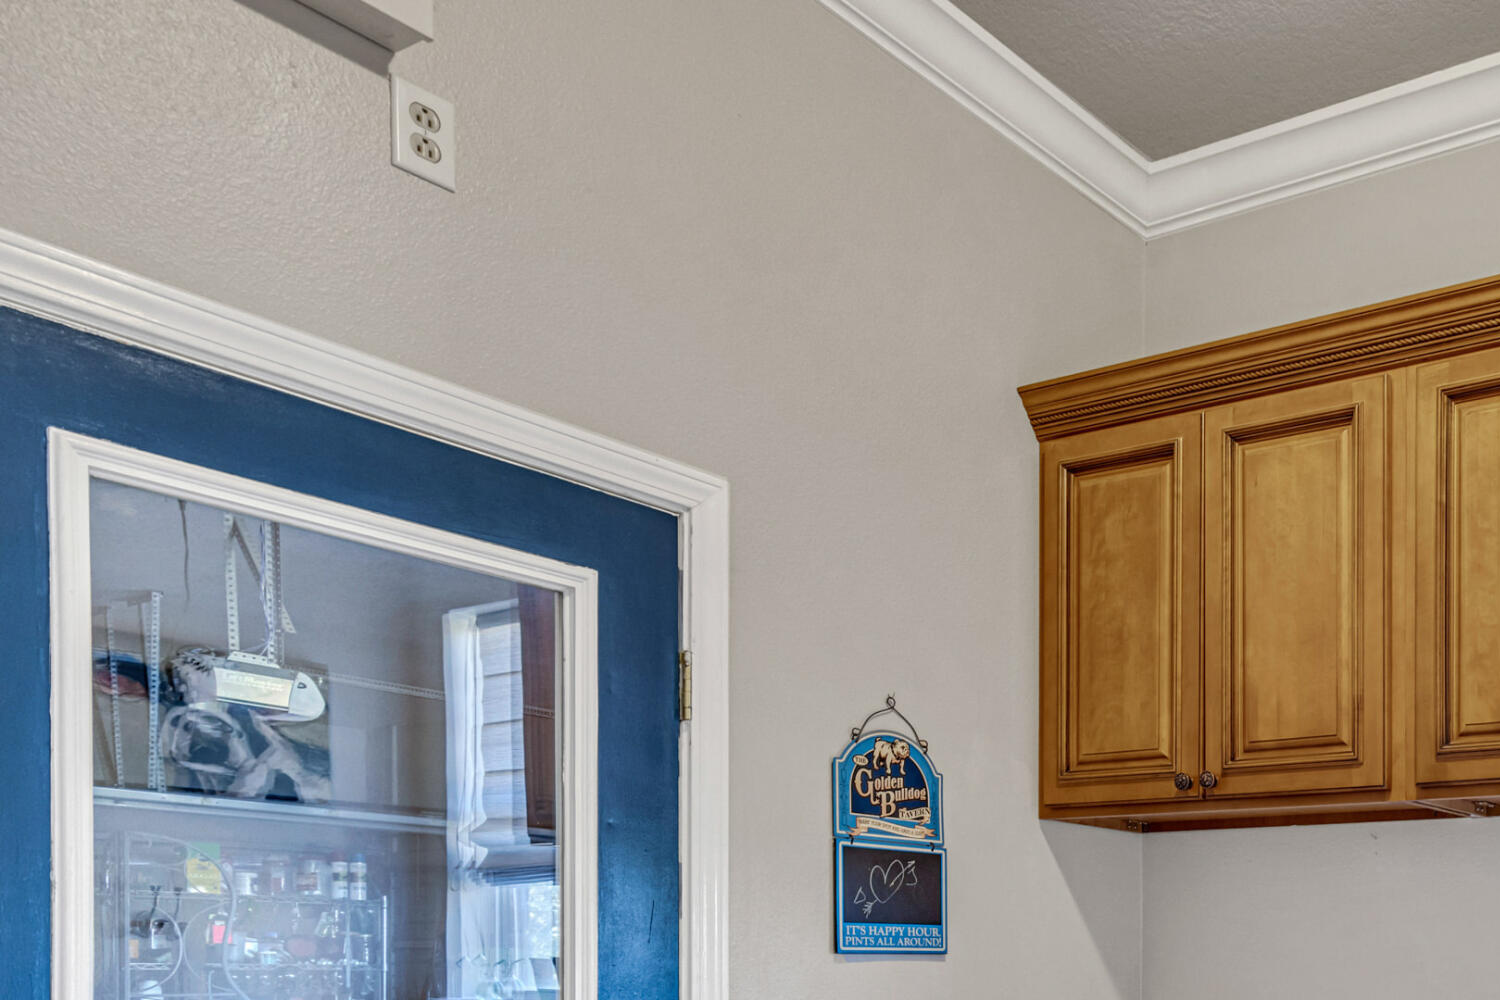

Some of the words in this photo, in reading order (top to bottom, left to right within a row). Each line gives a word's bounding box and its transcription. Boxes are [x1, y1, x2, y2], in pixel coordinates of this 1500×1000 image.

[854, 768, 904, 805] Golden
[876, 787, 927, 818] Bulldog
[901, 808, 931, 818] TAVERN
[845, 925, 866, 936] IT'S
[868, 926, 905, 937] HAPPY
[845, 936, 875, 946] PINTS
[876, 936, 895, 946] ALL
[897, 937, 942, 949] AROUND!
